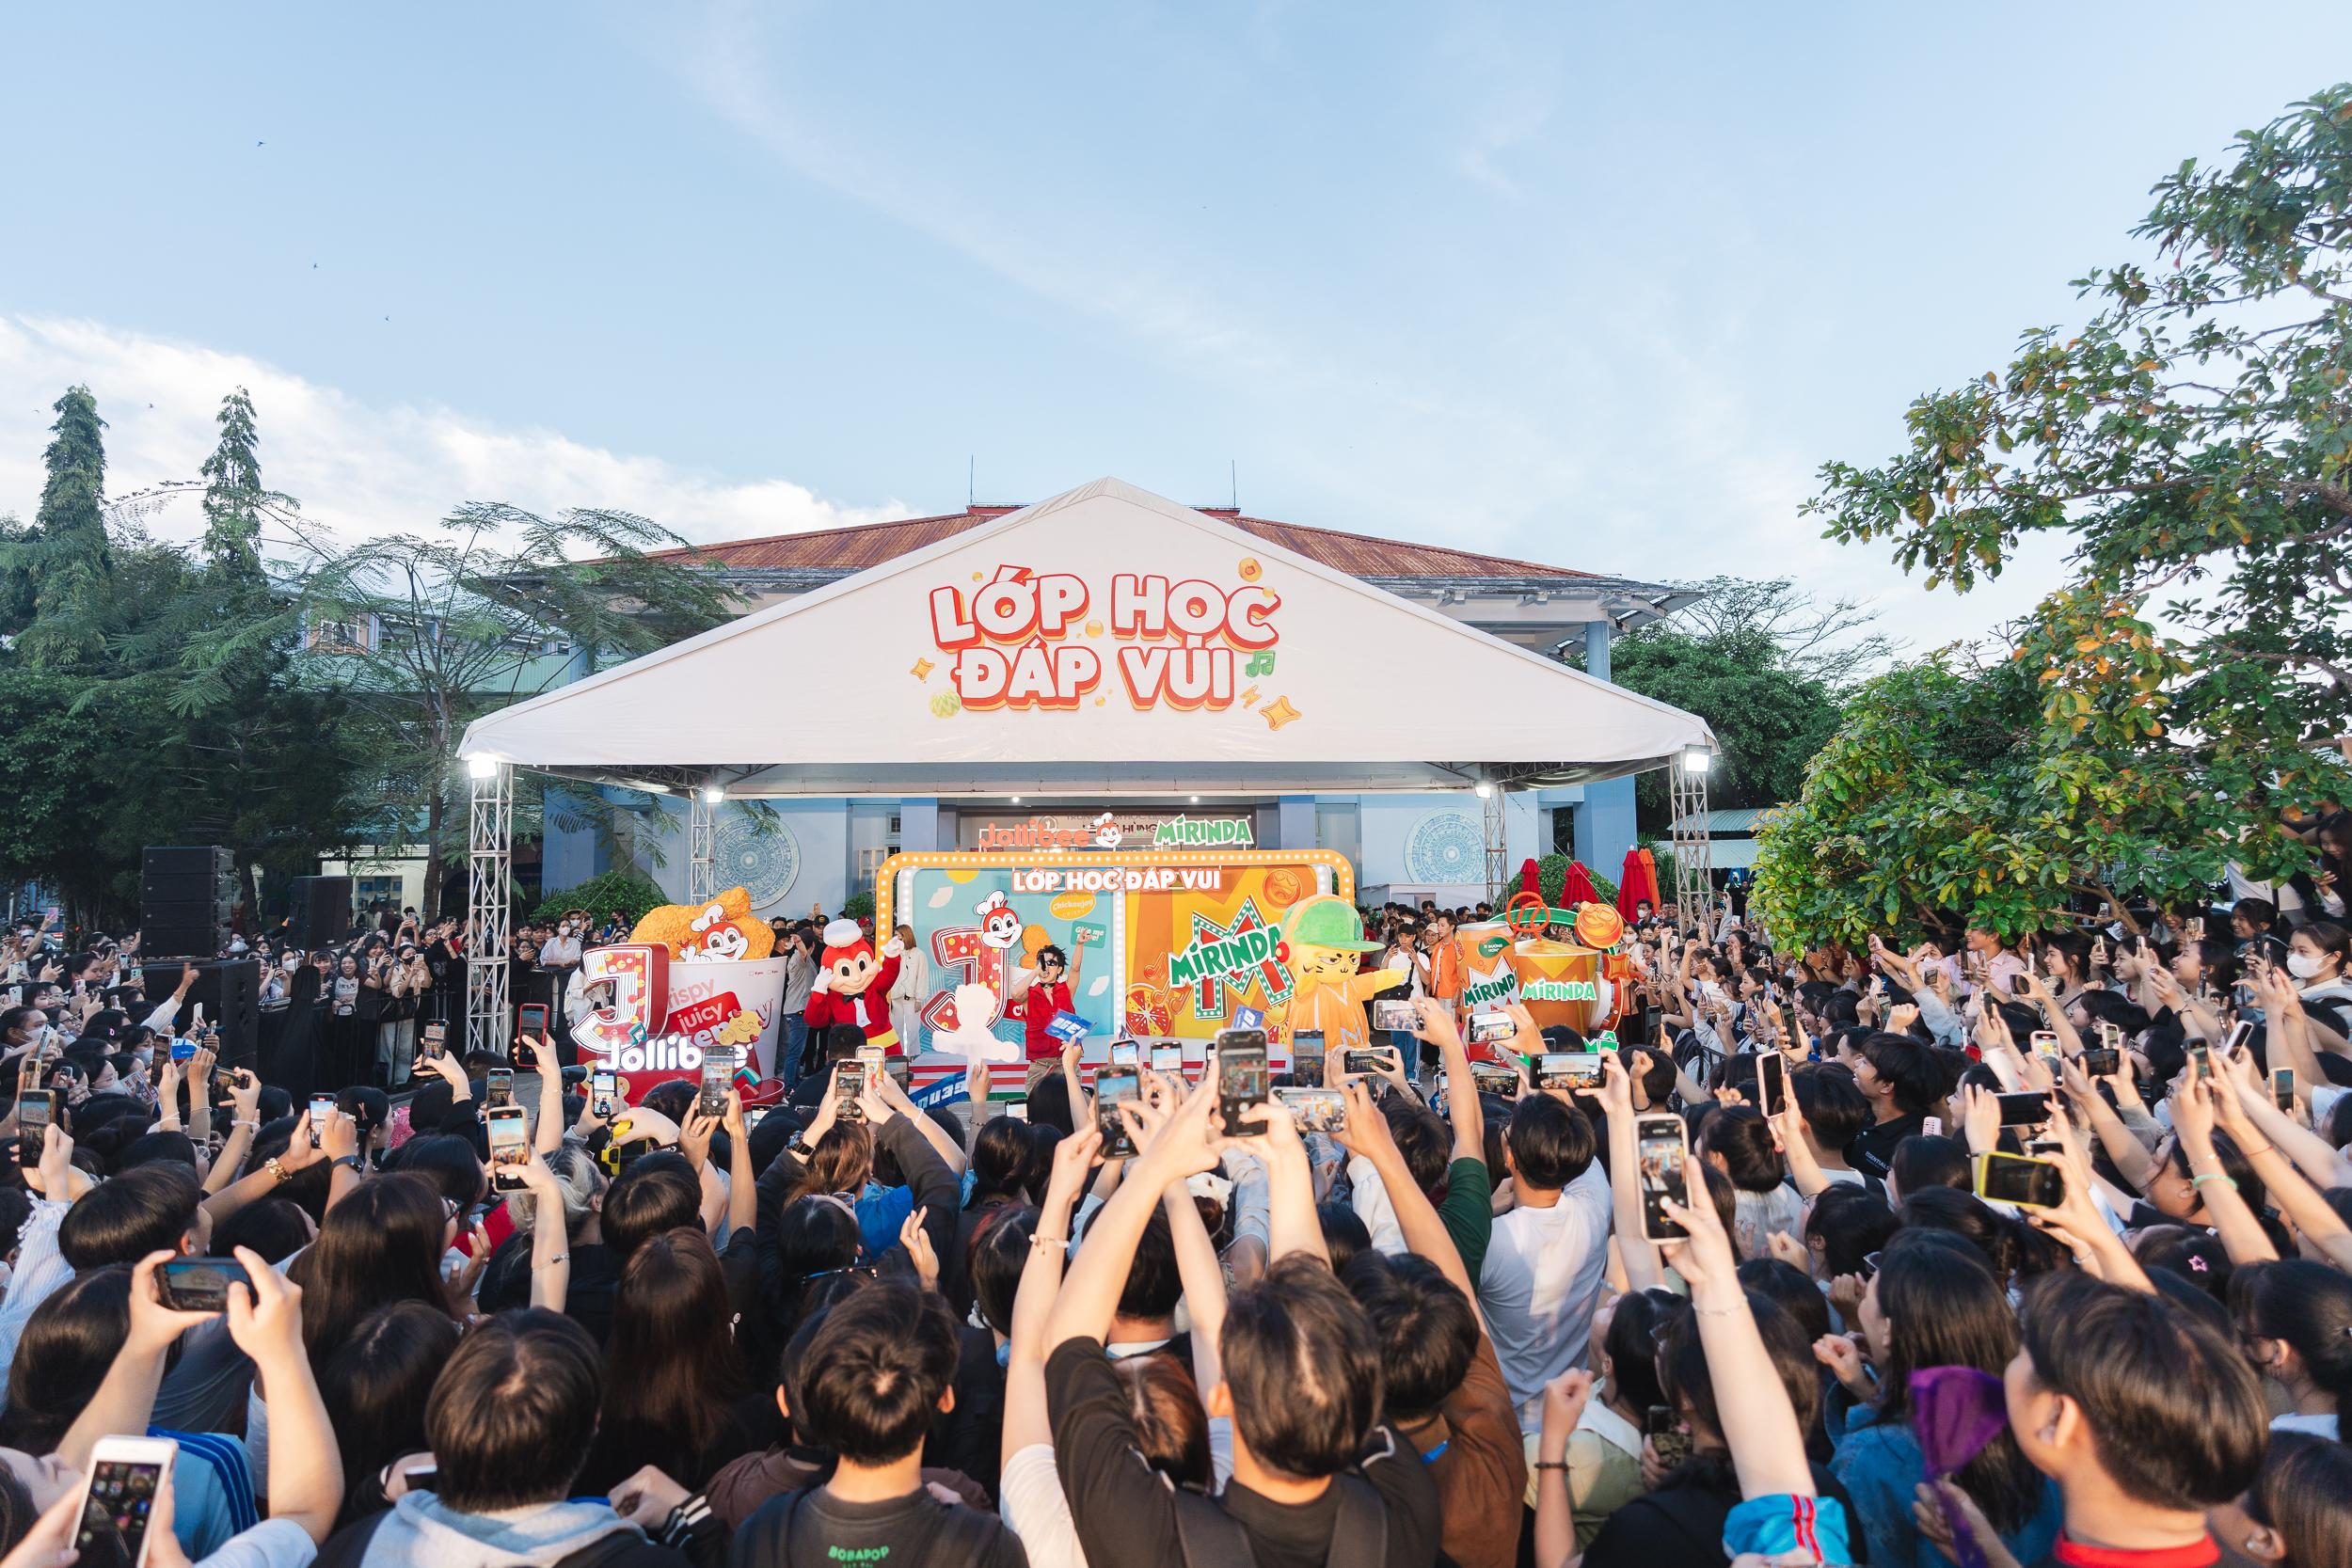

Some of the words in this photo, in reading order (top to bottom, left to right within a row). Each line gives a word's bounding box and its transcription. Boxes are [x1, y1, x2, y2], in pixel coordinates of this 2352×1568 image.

[930, 564, 1089, 654] LỚP
[1111, 574, 1281, 653] HỌC
[951, 634, 1101, 711] ĐÁP
[1118, 646, 1234, 711] VUI
[978, 819, 1089, 847] Jollibee
[1012, 867, 1060, 892] LỚP
[1064, 869, 1120, 894] HỌC
[1123, 866, 1175, 891] ĐÁP
[1180, 868, 1222, 891] VUI
[668, 978, 714, 1008] rispy
[1463, 970, 1518, 1006] MIRIND
[677, 1003, 723, 1035] juicy
[596, 1036, 749, 1071] Jollibe
